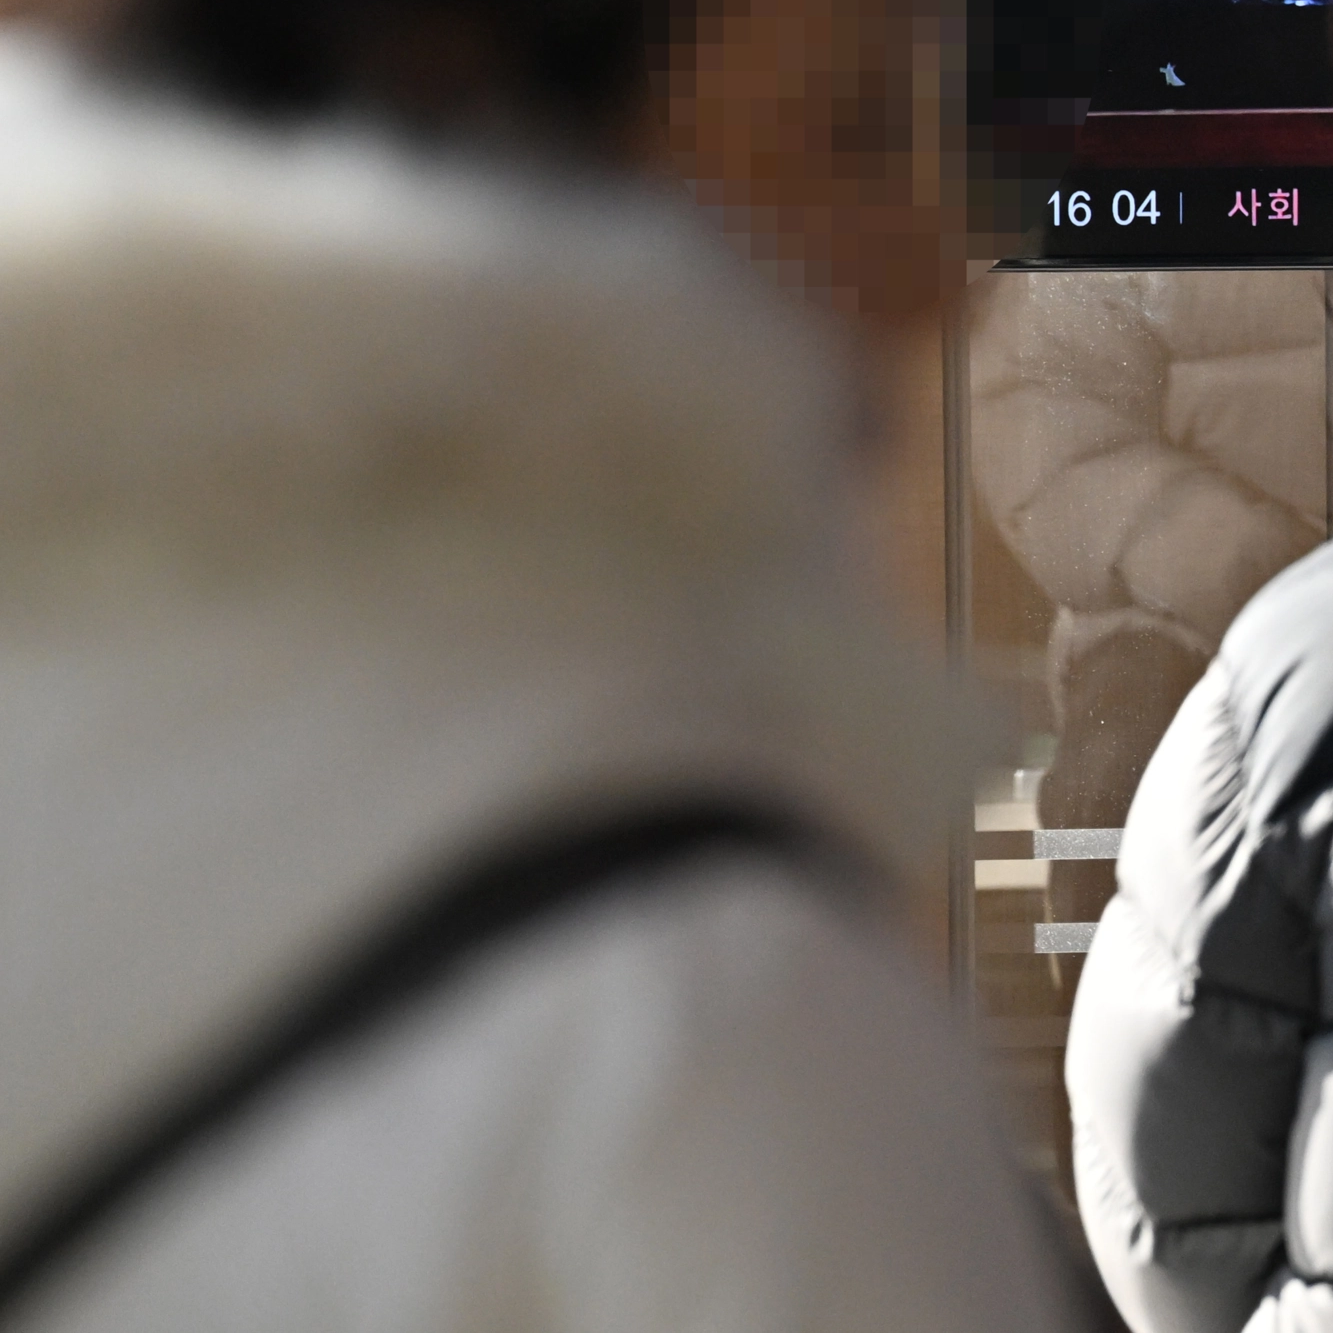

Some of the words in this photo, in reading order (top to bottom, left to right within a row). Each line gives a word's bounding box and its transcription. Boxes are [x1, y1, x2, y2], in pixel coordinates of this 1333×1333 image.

[1047, 190, 1091, 226] 16
[1112, 190, 1160, 225] 04
[1227, 188, 1299, 226] 사회
